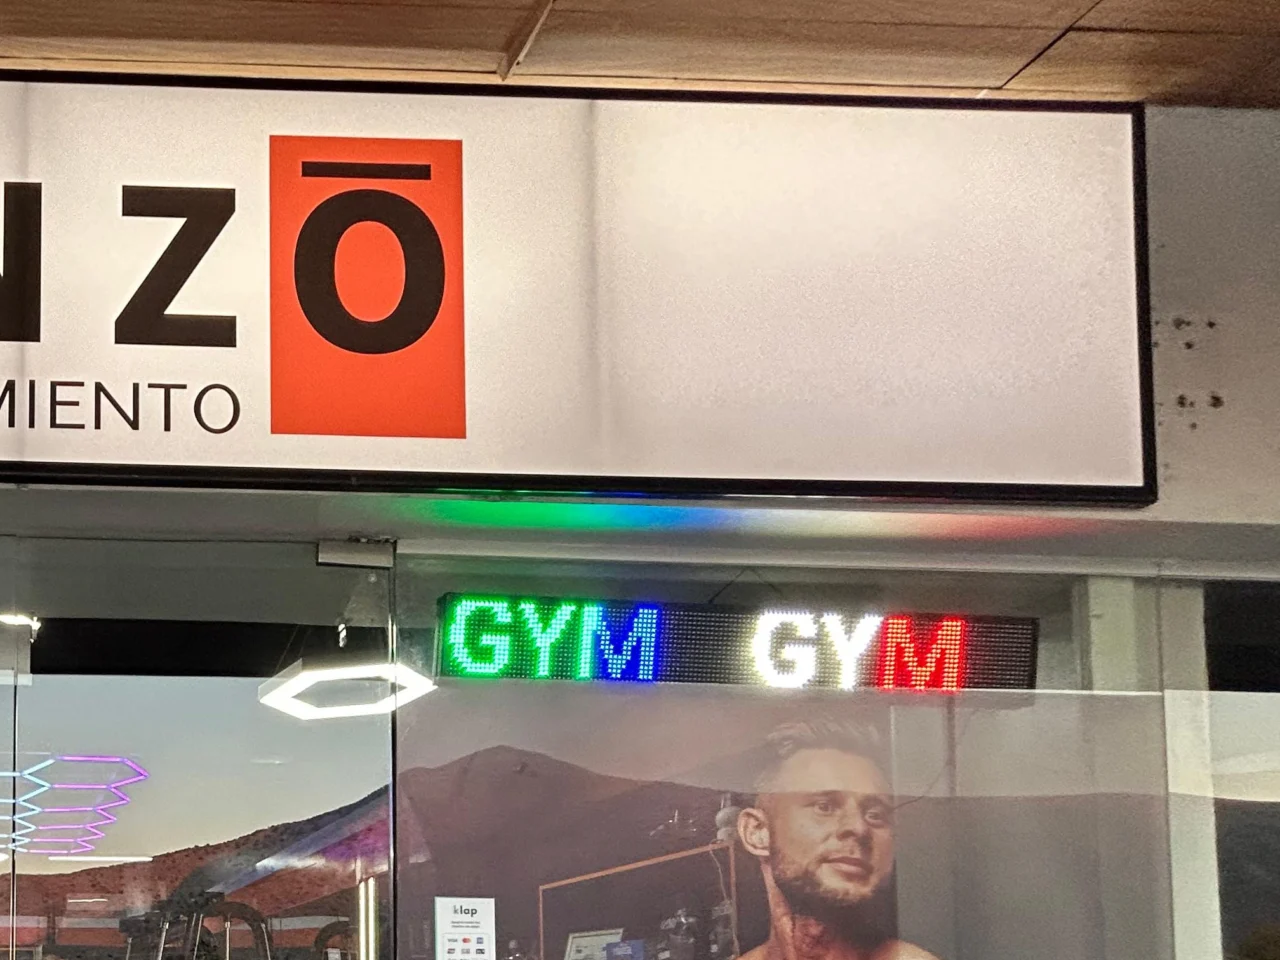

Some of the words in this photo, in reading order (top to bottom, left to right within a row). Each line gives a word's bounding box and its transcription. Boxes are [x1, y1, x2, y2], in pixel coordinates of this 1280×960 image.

[449, 598, 660, 681] GYM
[751, 609, 966, 693] GYM
[453, 904, 478, 917] klap
